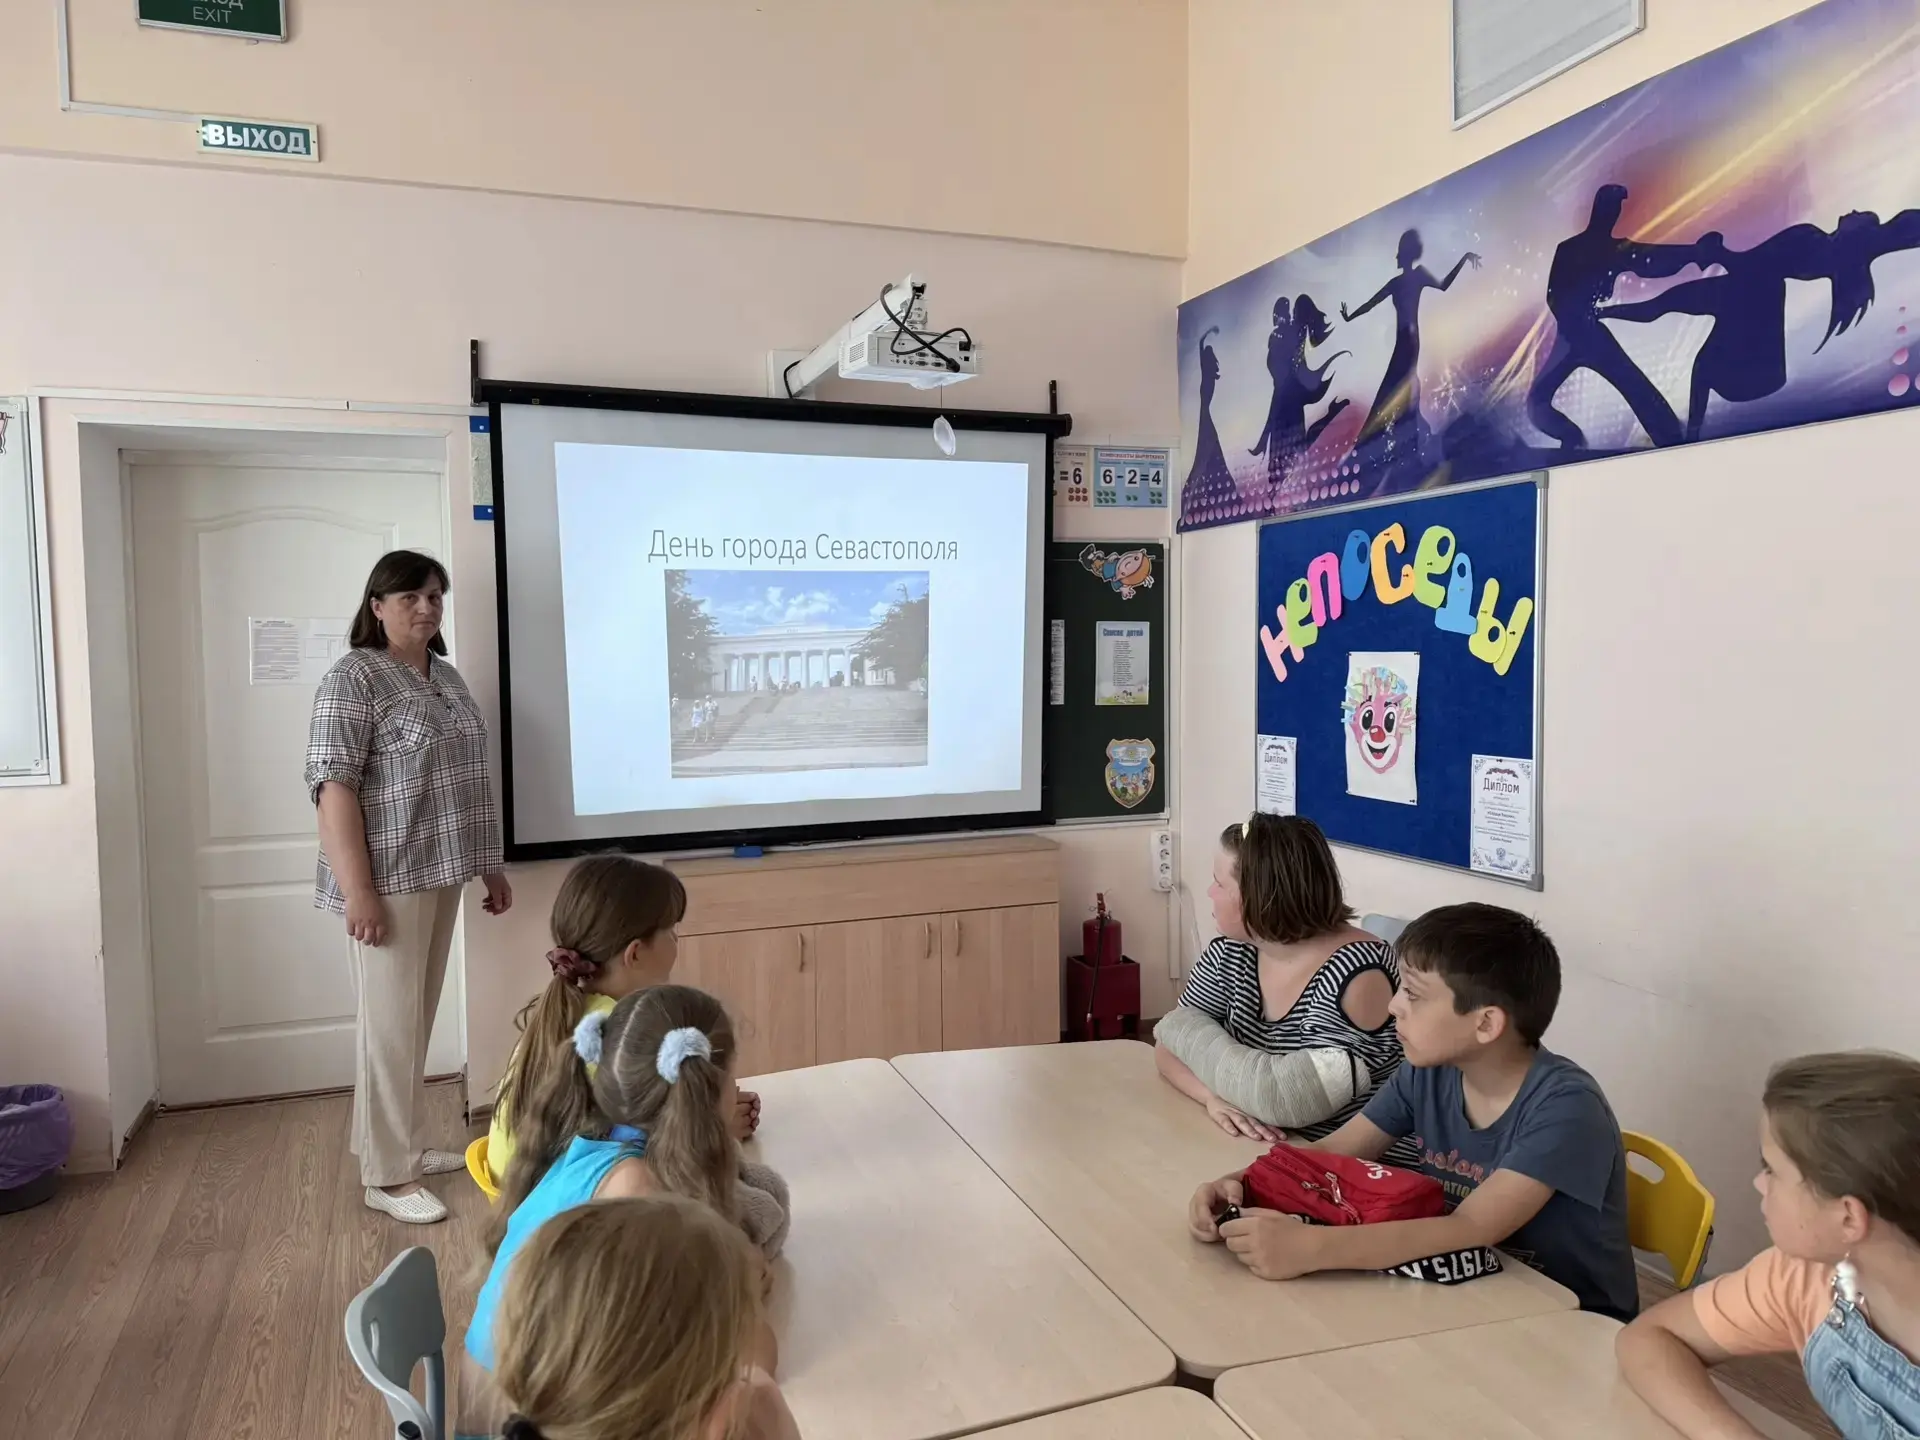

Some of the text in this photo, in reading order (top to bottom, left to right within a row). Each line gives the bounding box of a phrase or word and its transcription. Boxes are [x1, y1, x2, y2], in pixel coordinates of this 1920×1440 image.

[193, 6, 233, 24] EXIT
[205, 124, 307, 154] ВЫХОД
[647, 529, 959, 565] День города Севастополя
[1483, 777, 1520, 794] Диплом
